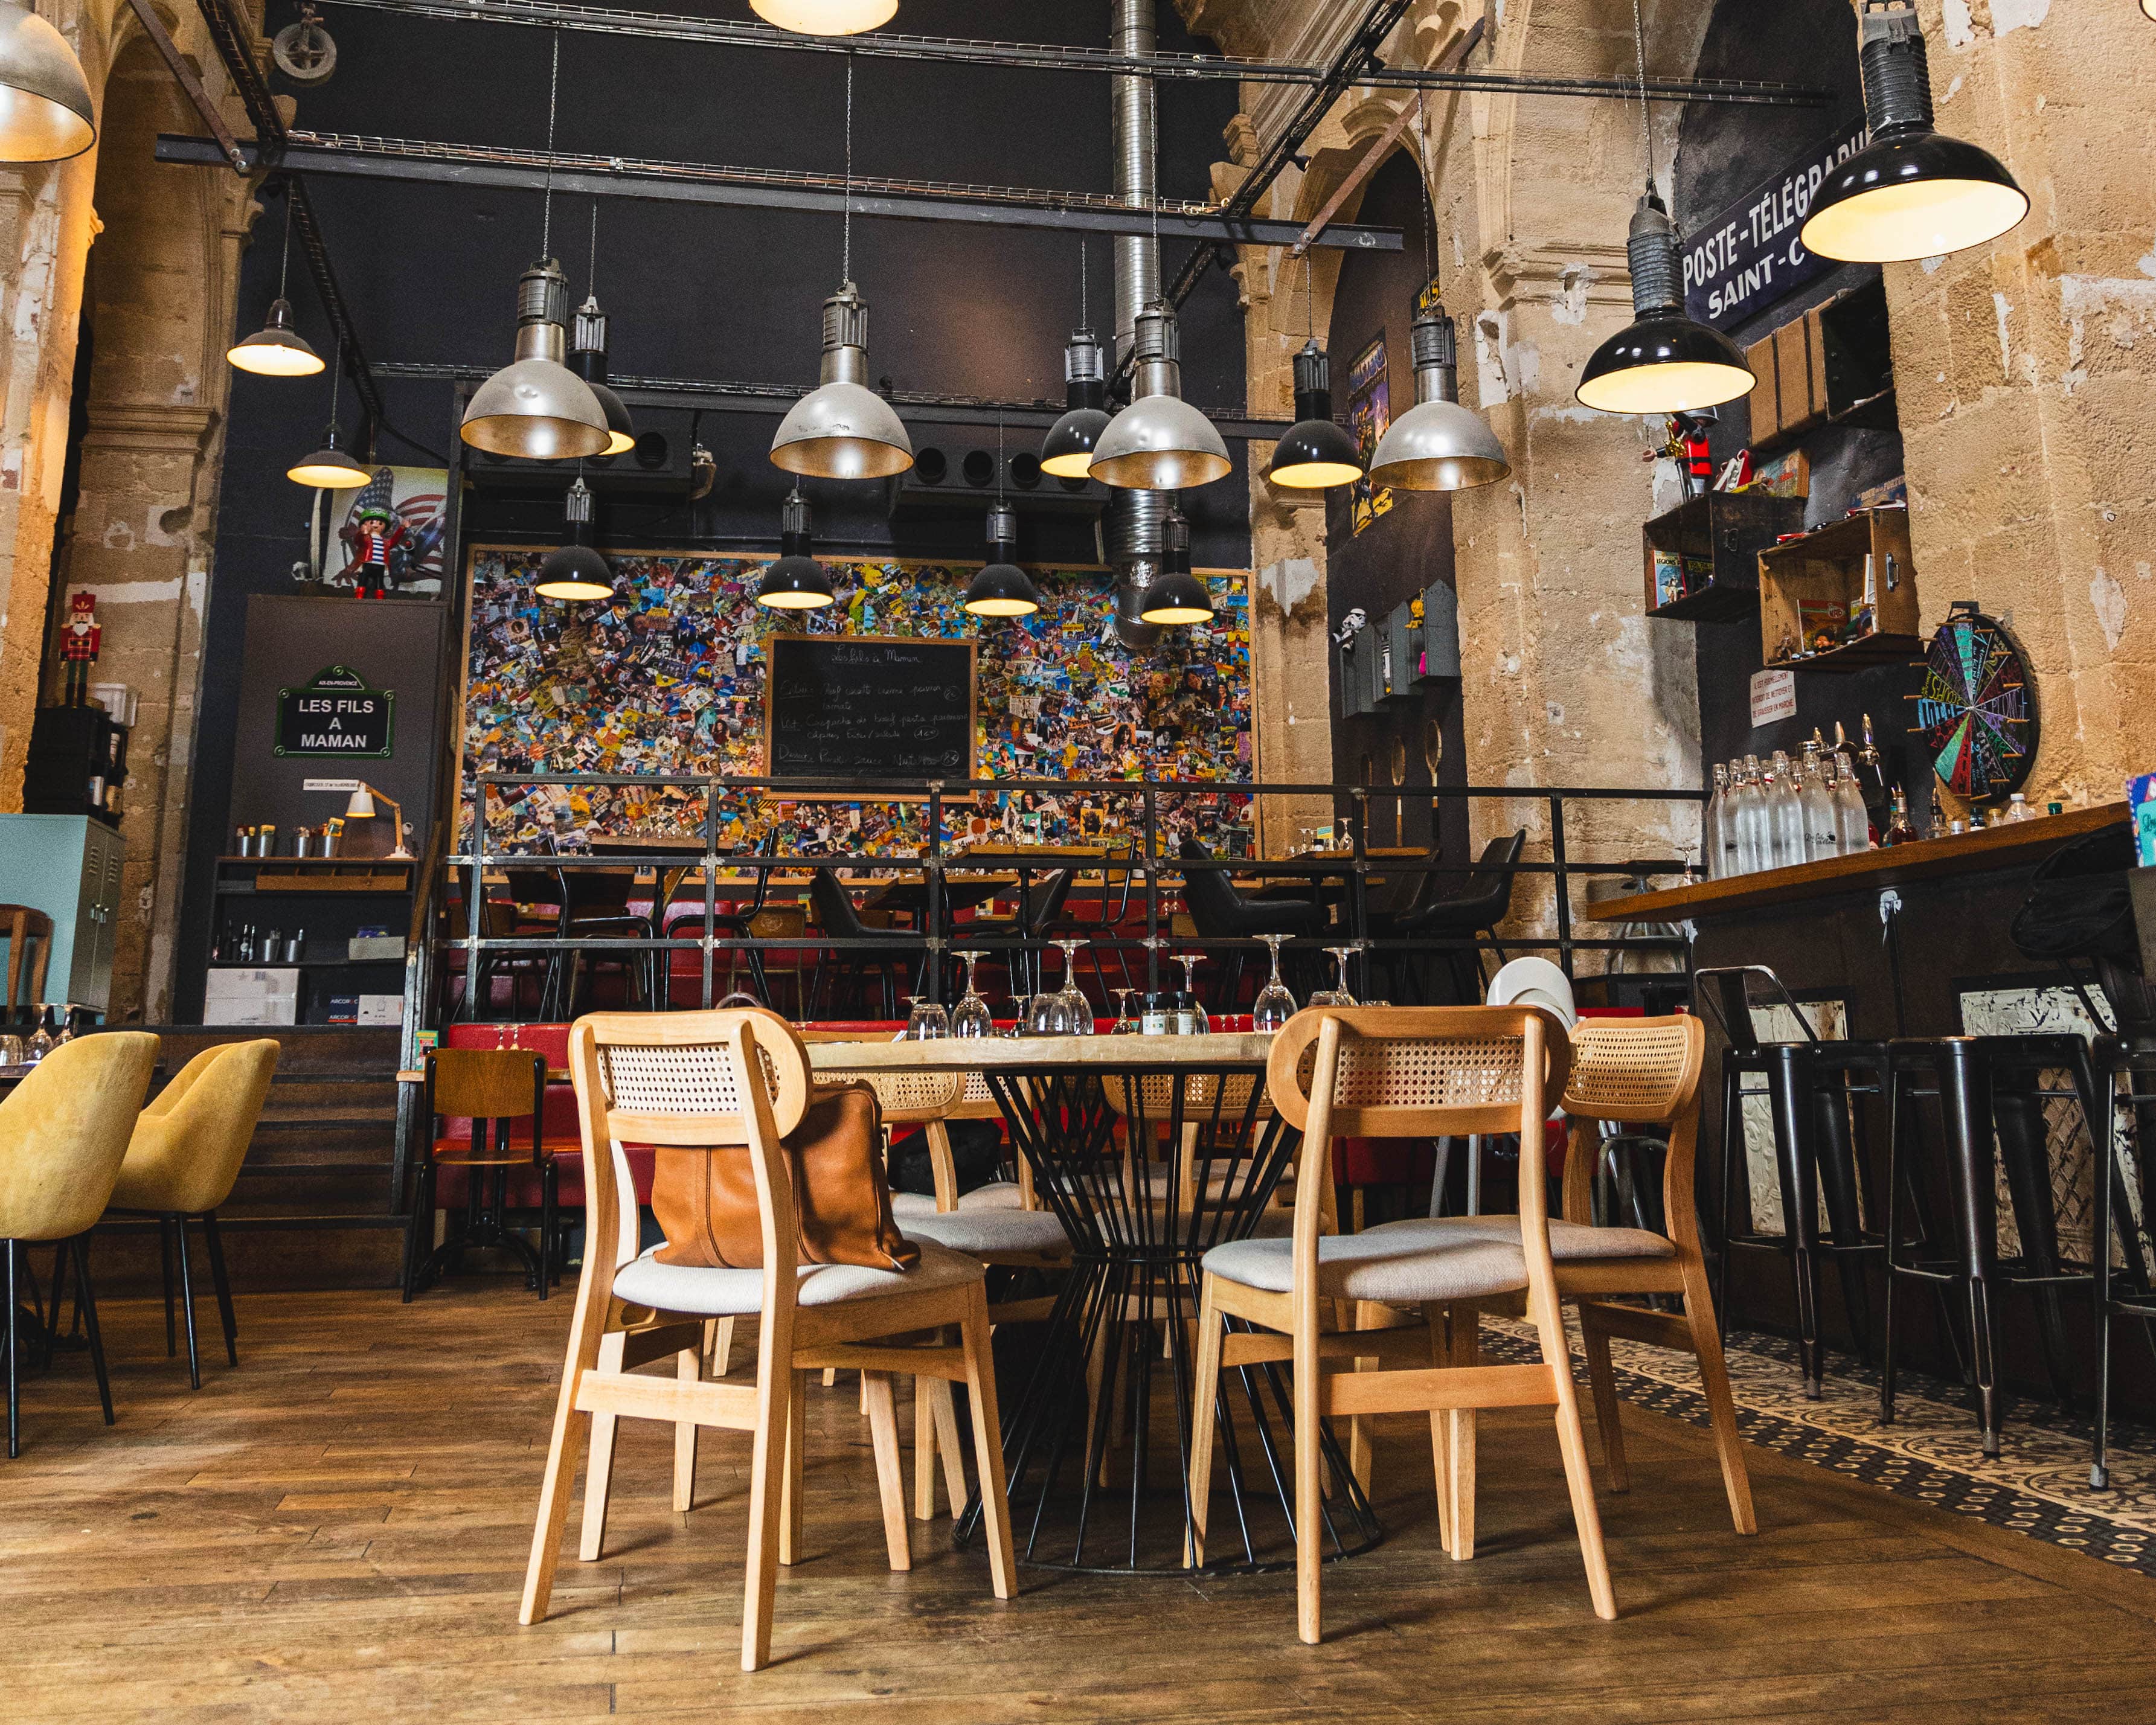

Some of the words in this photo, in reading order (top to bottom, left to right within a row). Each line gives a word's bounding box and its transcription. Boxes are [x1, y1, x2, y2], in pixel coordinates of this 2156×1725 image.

[1683, 127, 1871, 296] POSTE-TÉLÉGR
[299, 700, 332, 712] LES
[337, 700, 374, 713] FILS
[329, 717, 342, 730] A
[301, 734, 367, 747] MAMAN
